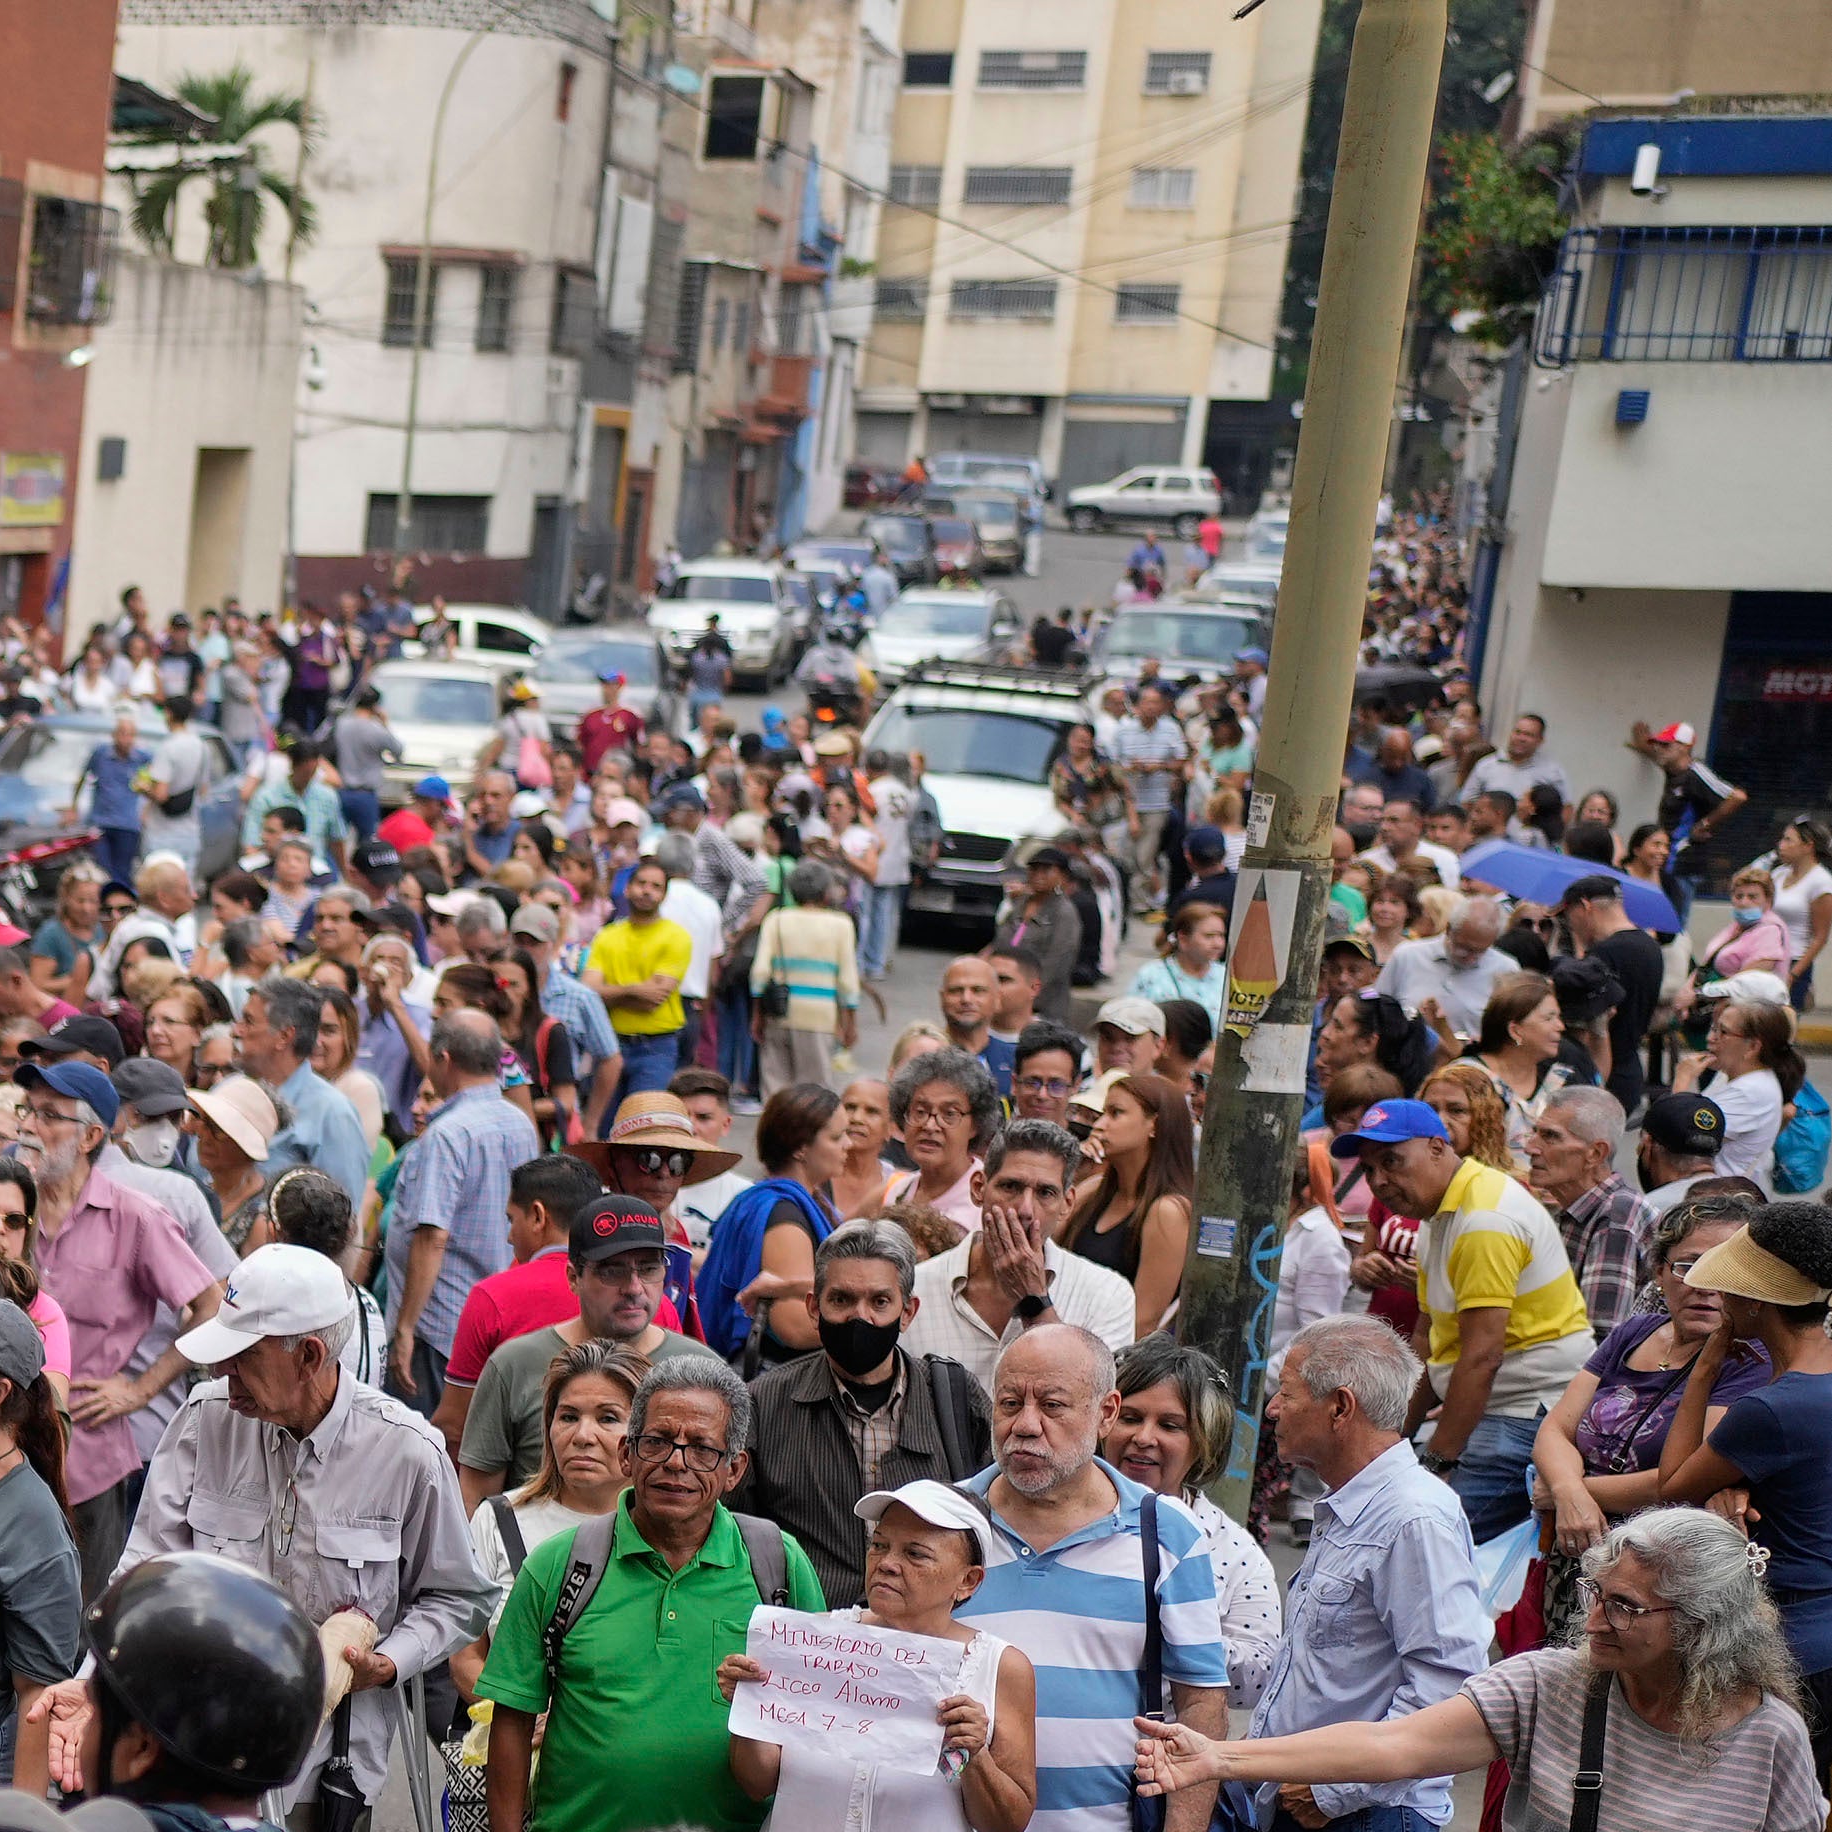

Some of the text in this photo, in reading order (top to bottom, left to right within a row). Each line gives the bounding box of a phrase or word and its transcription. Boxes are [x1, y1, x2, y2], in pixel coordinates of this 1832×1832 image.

[618, 1214, 660, 1226] JAGUAR
[770, 1621, 930, 1666] MINISTERIO DEL
[800, 1654, 879, 1680] TRABAJO
[835, 1680, 902, 1710] Alamo
[759, 1703, 805, 1726] MESA
